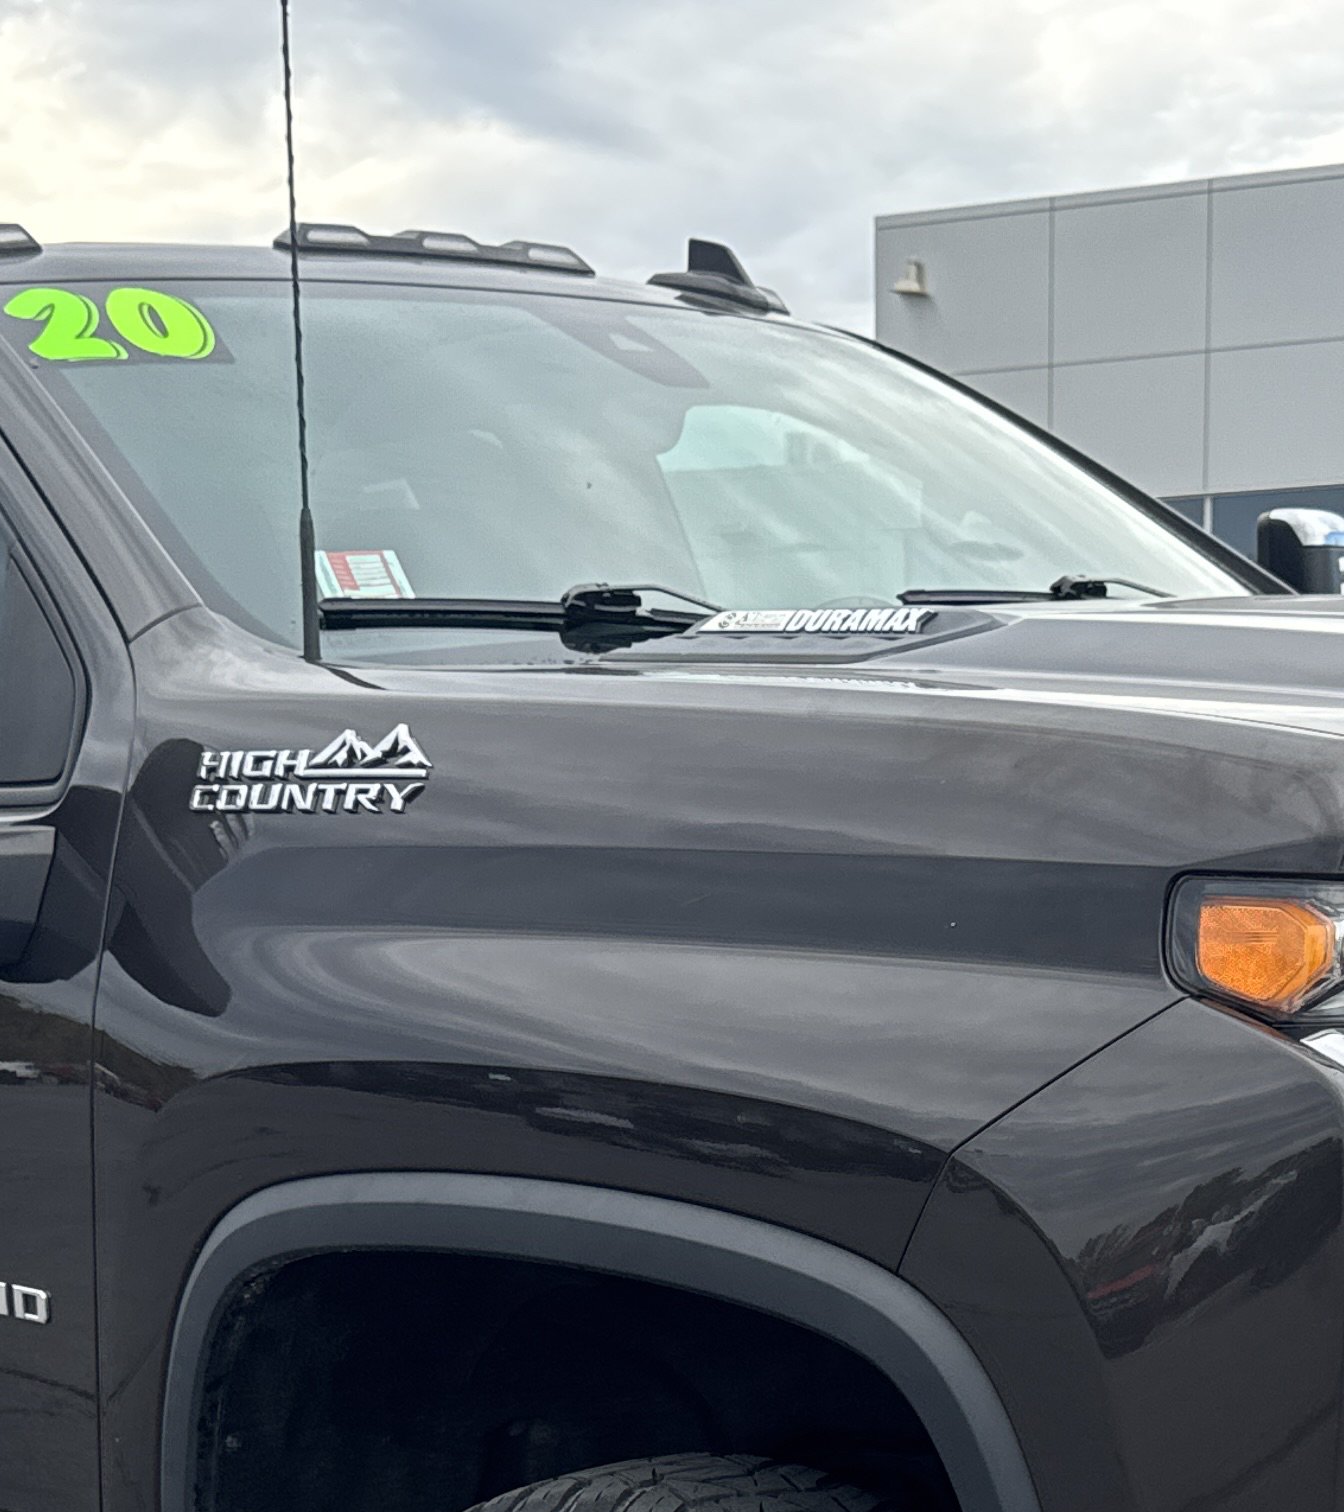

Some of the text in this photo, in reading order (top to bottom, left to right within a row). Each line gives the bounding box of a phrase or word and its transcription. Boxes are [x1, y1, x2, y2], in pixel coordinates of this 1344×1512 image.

[3, 287, 216, 362] 20
[785, 607, 937, 635] DURAMAX
[197, 748, 313, 780] HIGH
[189, 782, 426, 813] COUNTRY
